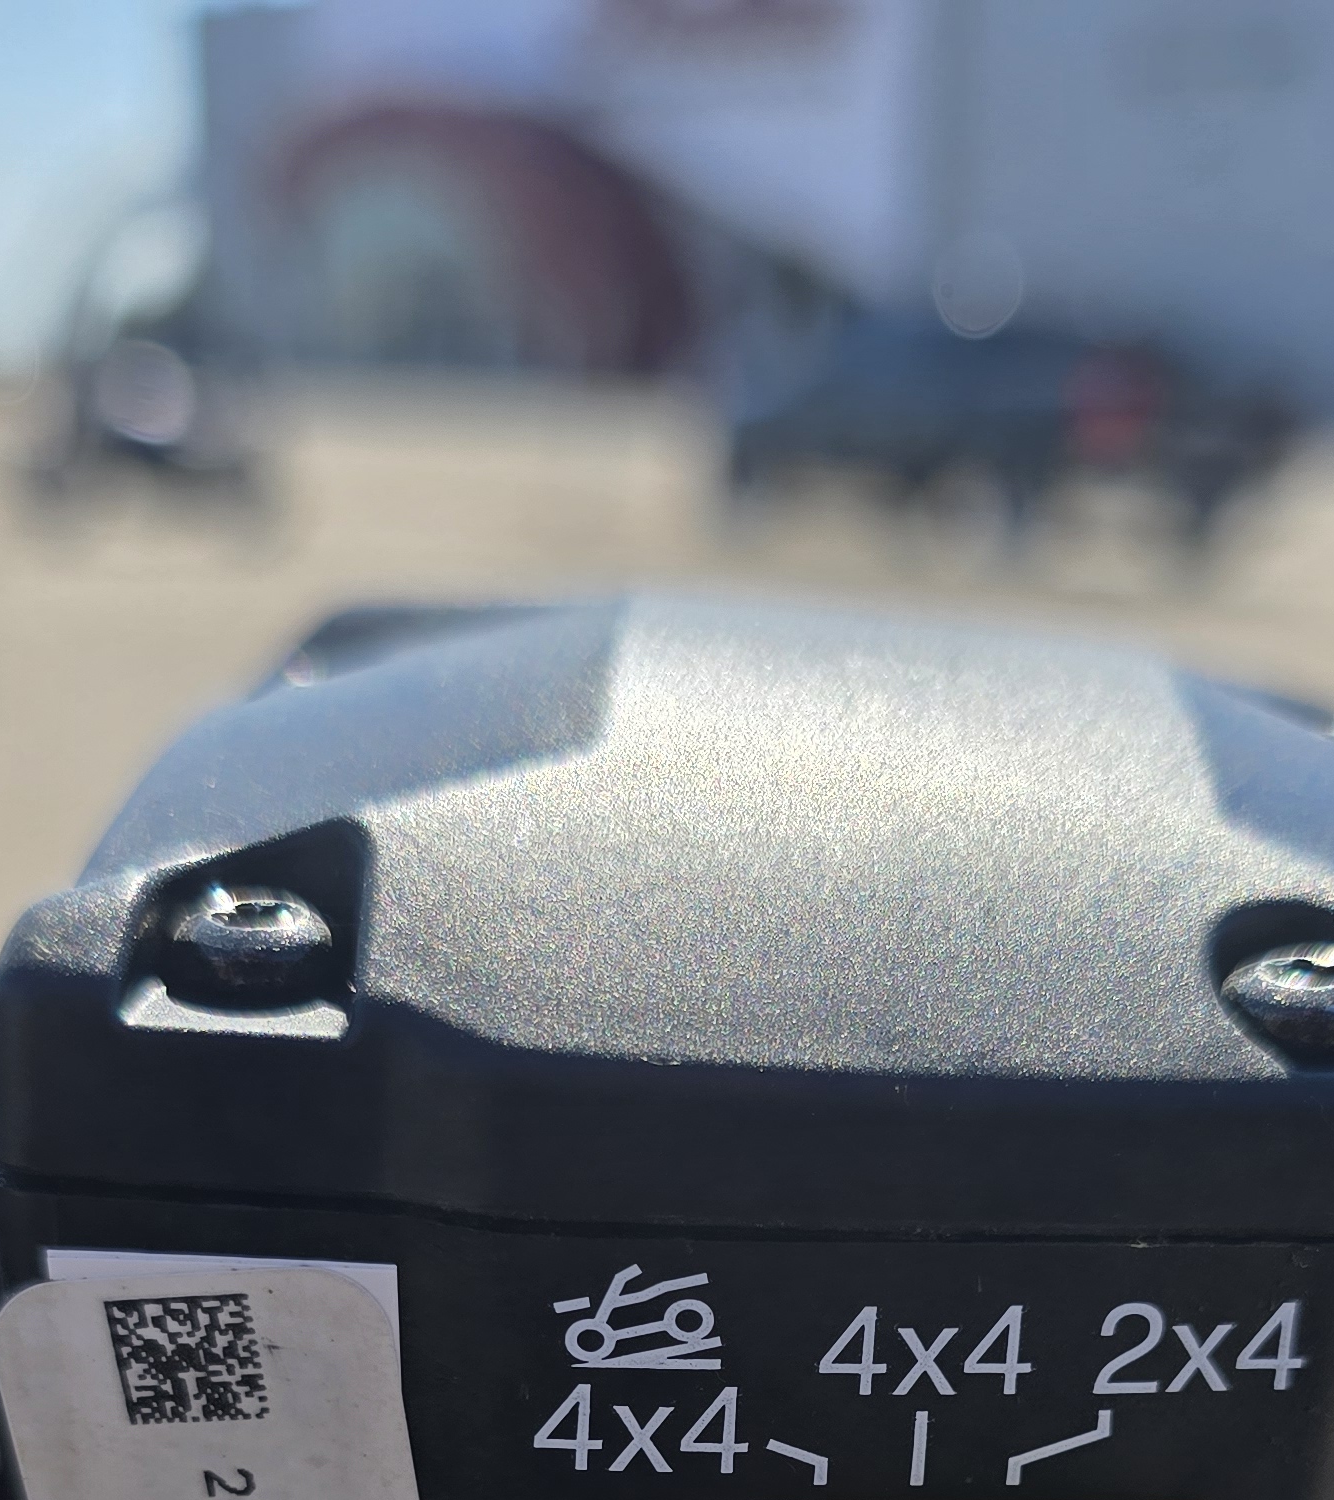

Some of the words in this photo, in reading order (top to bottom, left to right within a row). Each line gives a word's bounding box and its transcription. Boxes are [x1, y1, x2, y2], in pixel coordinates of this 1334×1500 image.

[817, 1304, 1033, 1397] 4x4
[1091, 1300, 1306, 1396] 2x4
[532, 1382, 750, 1475] 4x4
